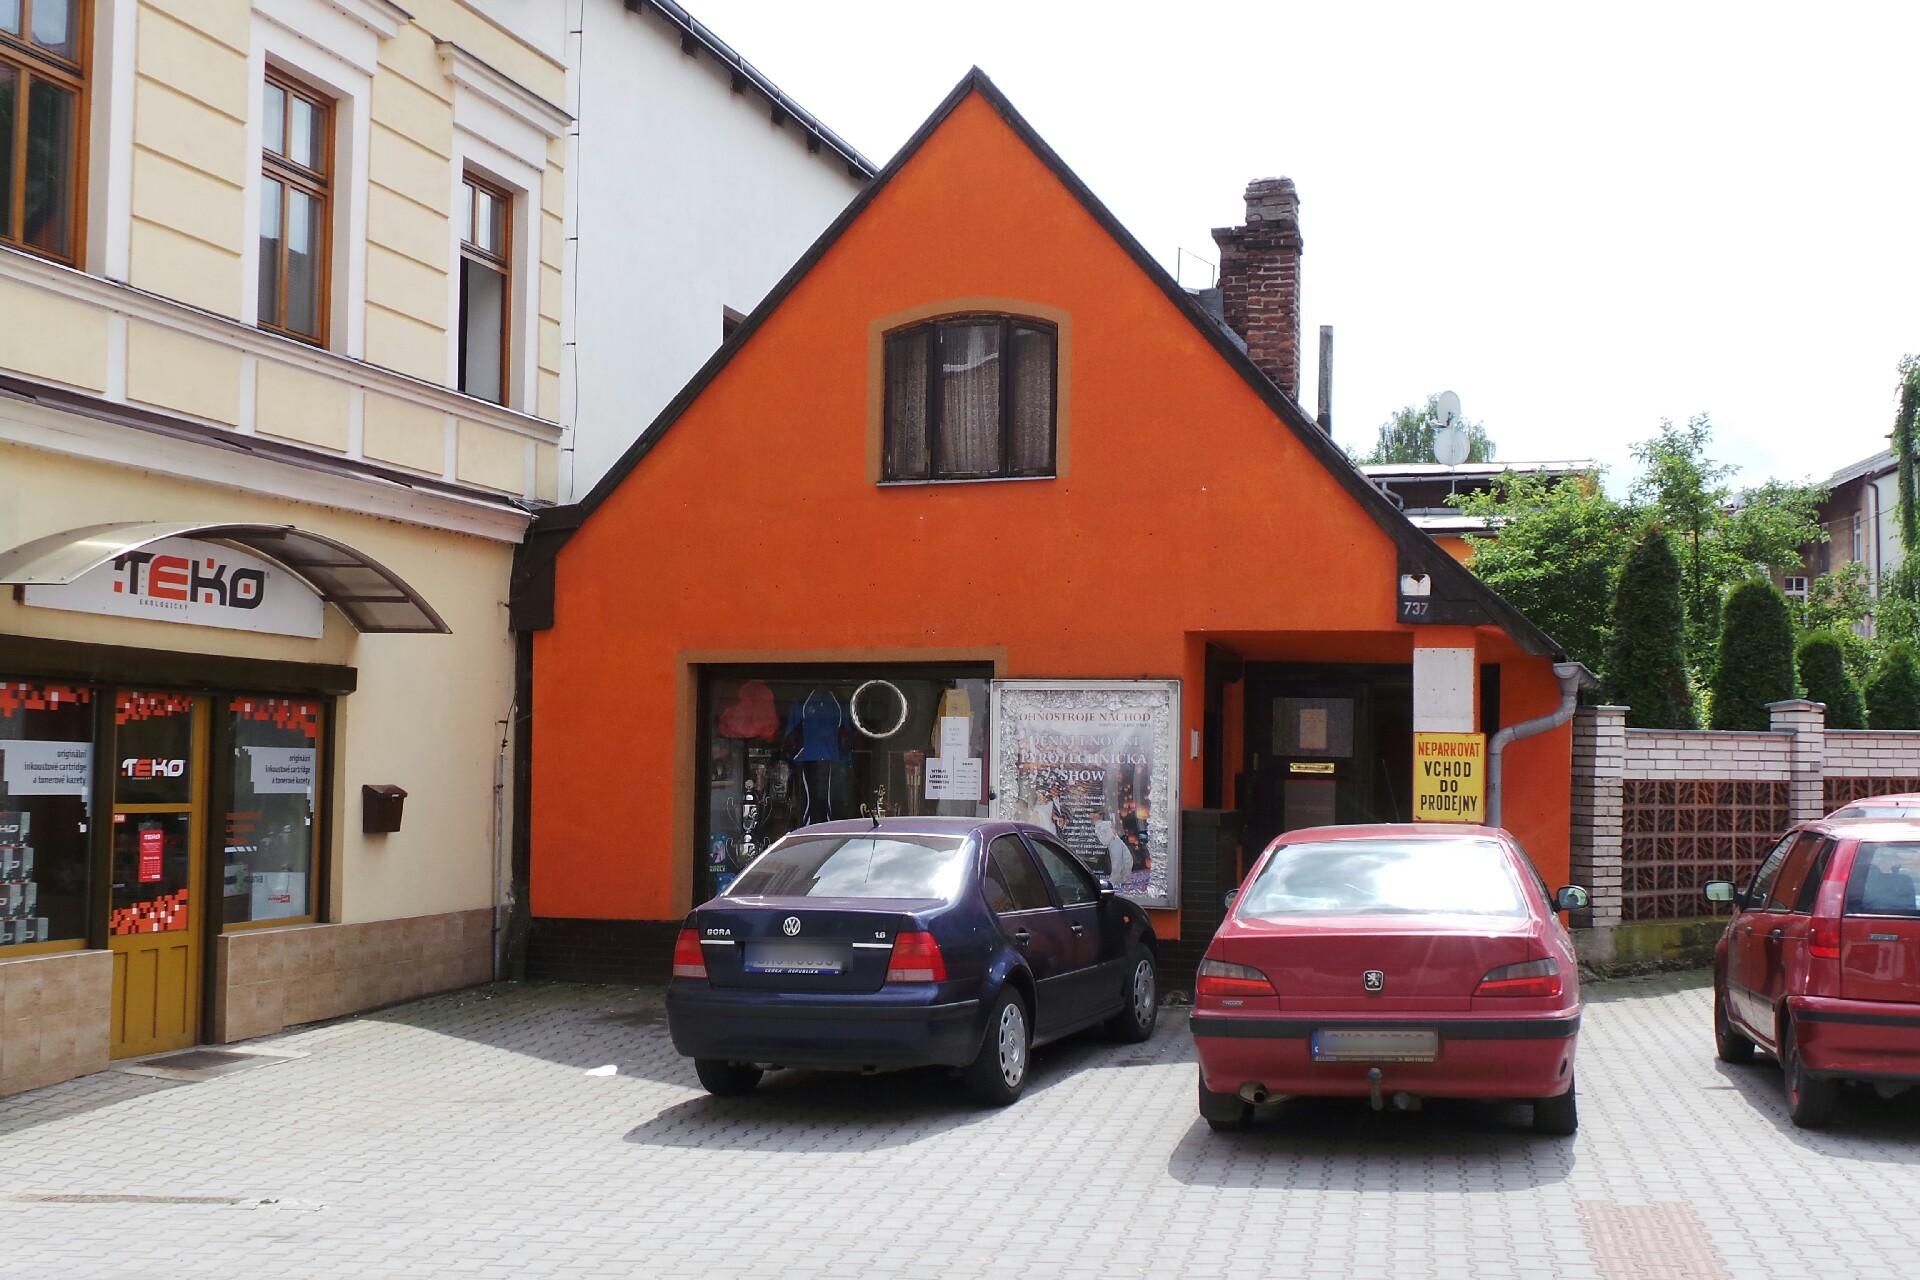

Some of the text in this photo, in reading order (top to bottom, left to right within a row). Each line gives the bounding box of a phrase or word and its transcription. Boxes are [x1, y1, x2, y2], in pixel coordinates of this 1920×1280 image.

[110, 550, 265, 610] TEKO
[1403, 601, 1429, 616] 737
[1417, 741, 1481, 758] NEPARKOVAT
[121, 758, 185, 777] TEKO
[1060, 770, 1106, 781] SHOW
[1424, 760, 1472, 778] VCHOD
[1439, 779, 1459, 793] DO
[1420, 794, 1478, 816] PRODEJNY
[706, 928, 732, 937] BORA
